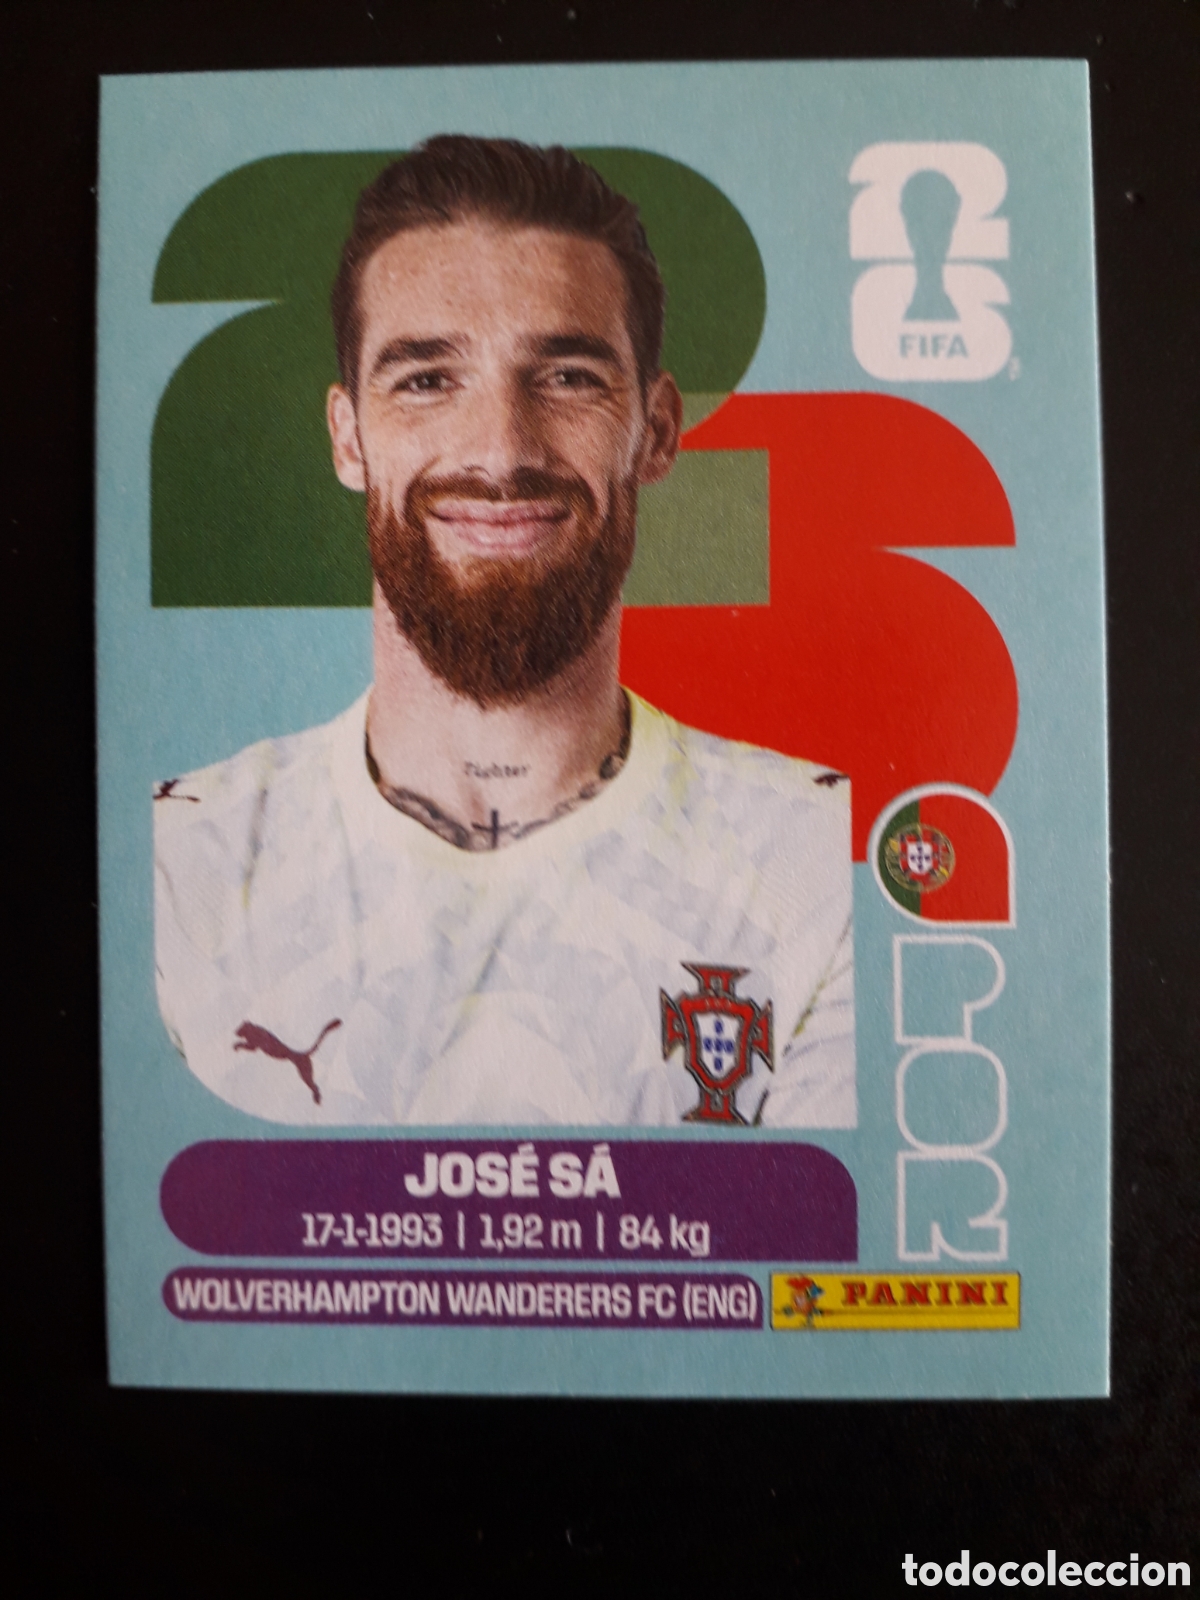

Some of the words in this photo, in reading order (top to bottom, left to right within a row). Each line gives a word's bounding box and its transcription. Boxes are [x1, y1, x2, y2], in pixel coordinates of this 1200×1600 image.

[900, 335, 967, 359] FIFA
[404, 1143, 540, 1198] JOSÉ
[548, 1143, 621, 1199] SÁ
[301, 1212, 443, 1249] 17-1-1993
[479, 1214, 543, 1253] 1,92
[551, 1222, 581, 1249] m
[619, 1215, 662, 1250] 84
[669, 1213, 711, 1257] kg
[172, 1276, 442, 1316] WOLVERHAMPTON
[446, 1281, 632, 1318] WANDERERS
[637, 1284, 677, 1318] FC
[683, 1281, 758, 1322] (ENG)
[842, 1280, 1010, 1306] PANINI
